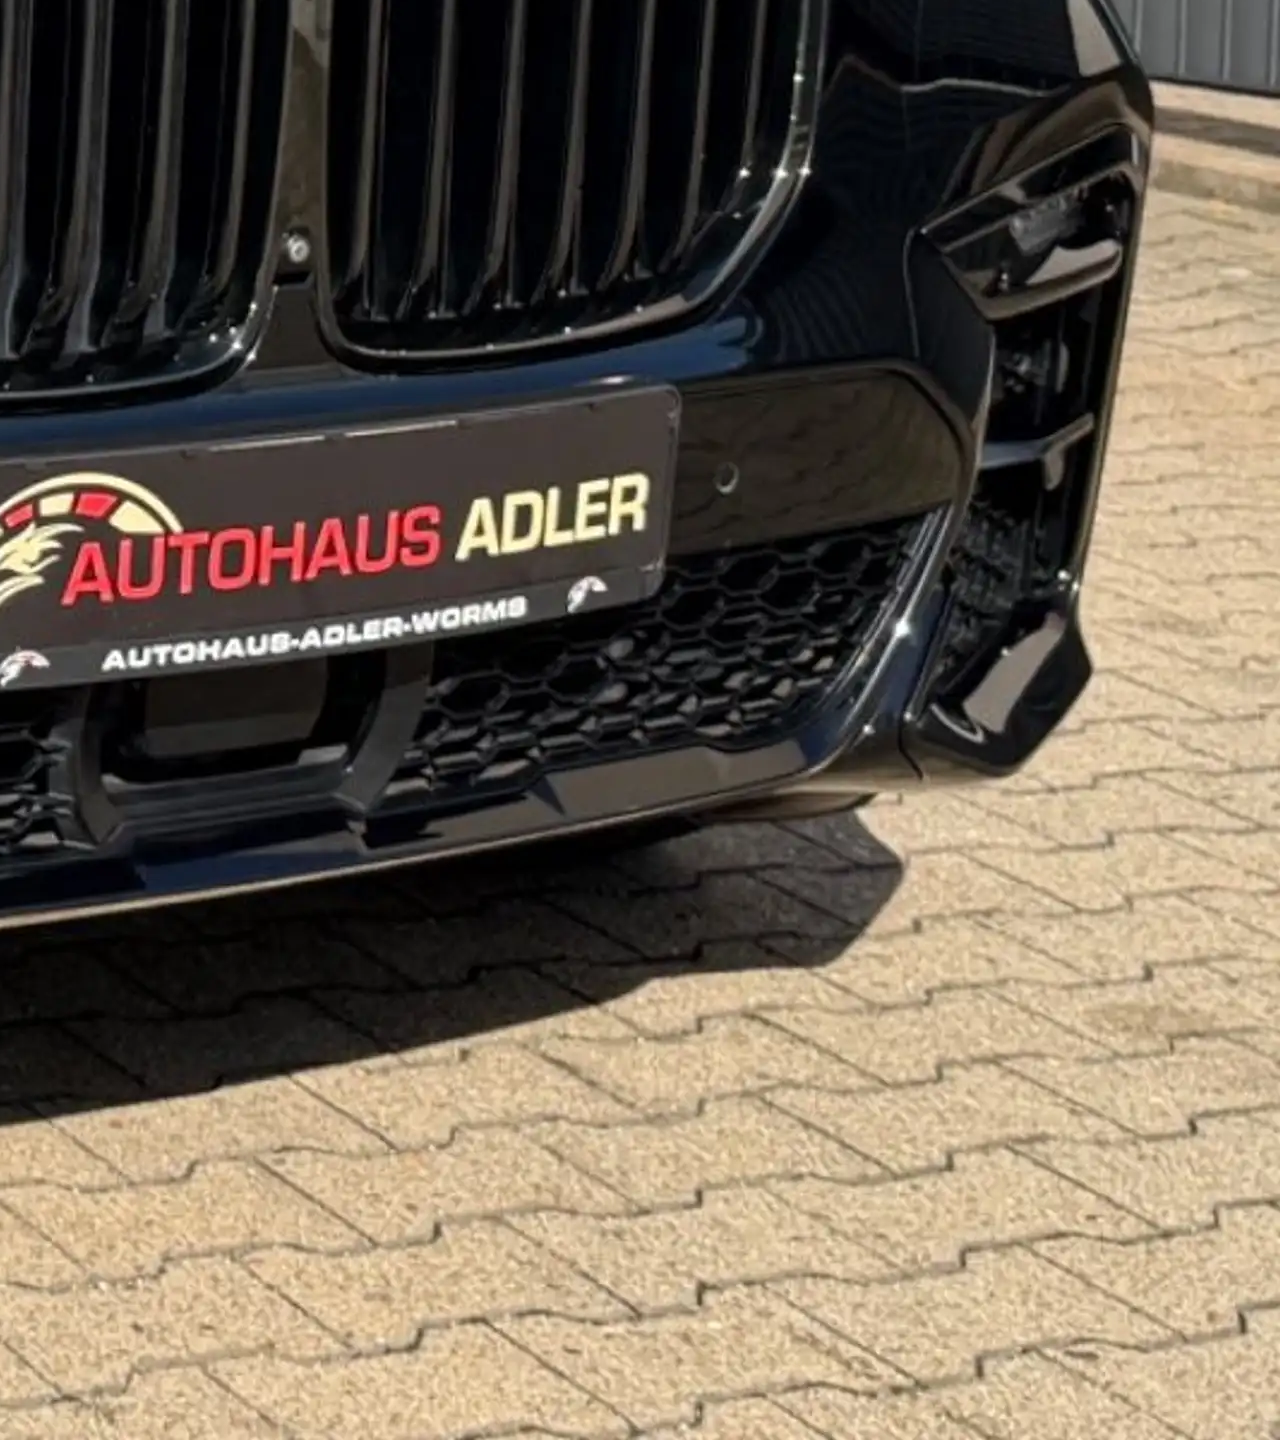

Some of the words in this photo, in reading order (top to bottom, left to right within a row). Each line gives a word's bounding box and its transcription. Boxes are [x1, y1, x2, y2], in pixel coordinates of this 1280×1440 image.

[60, 505, 442, 606] AUTOHAUS
[454, 471, 651, 562] ADLER
[100, 595, 528, 672] AUTOHAUS-ADLER-WORMS
